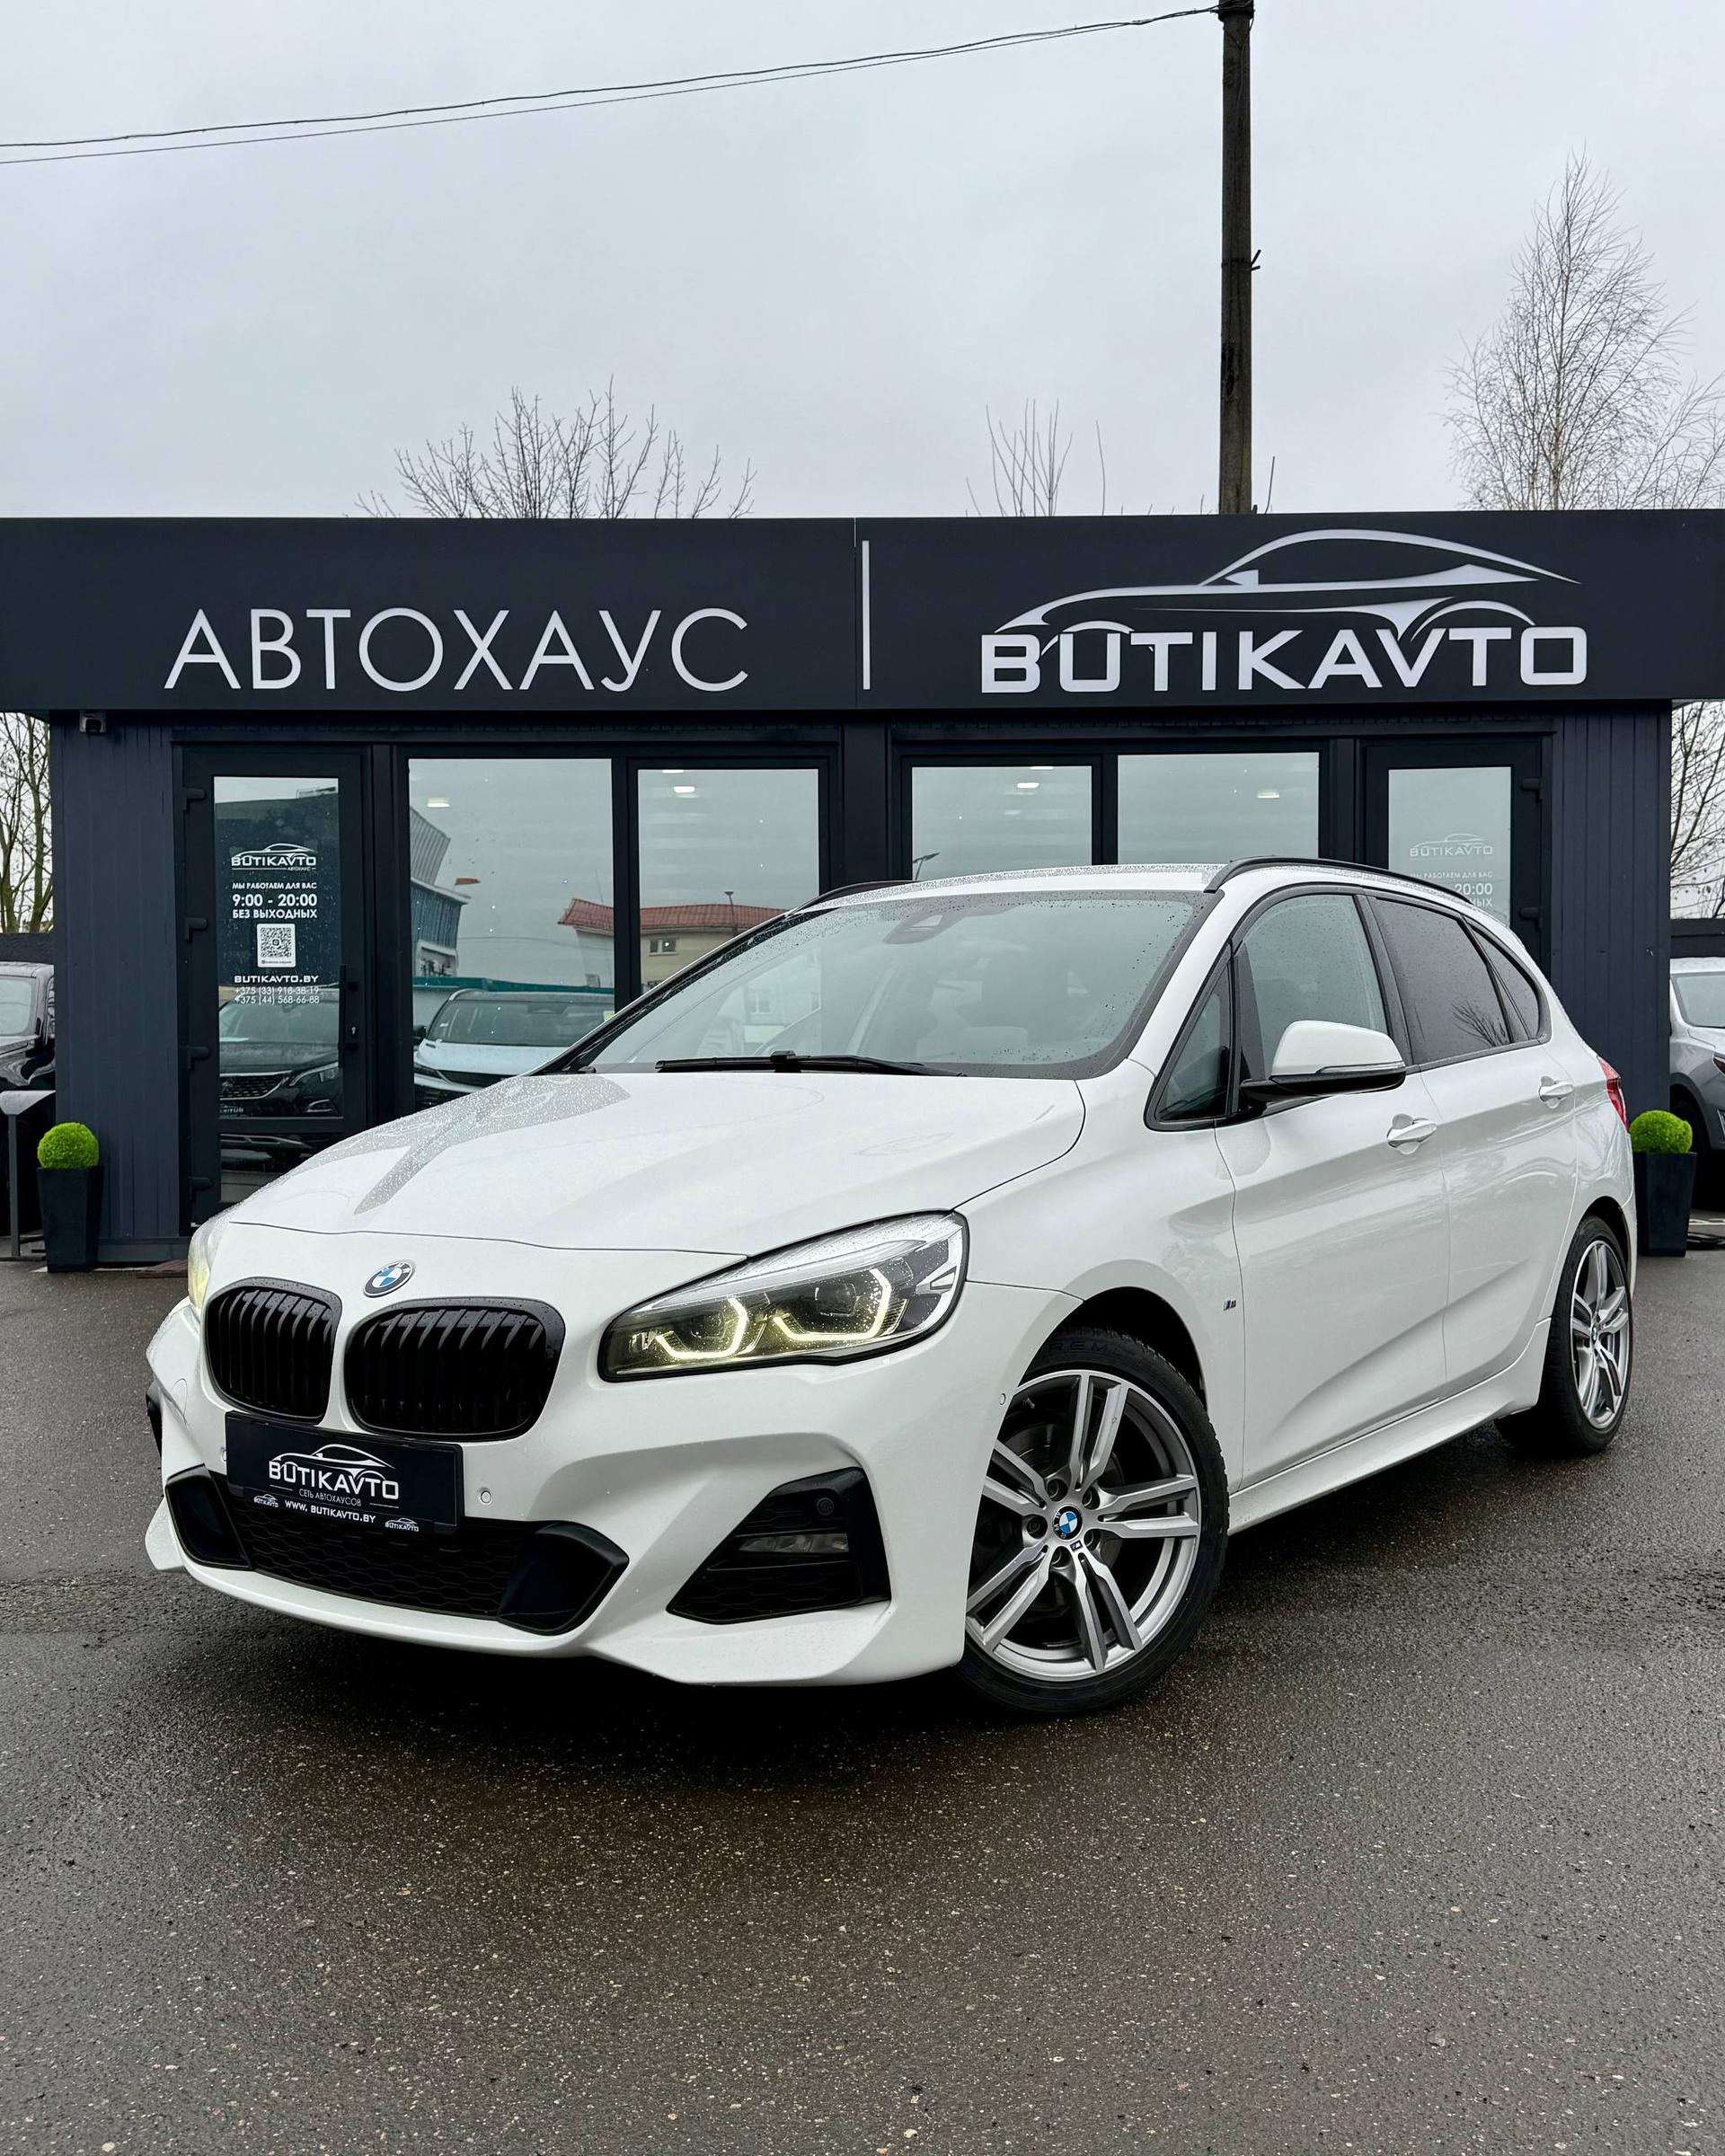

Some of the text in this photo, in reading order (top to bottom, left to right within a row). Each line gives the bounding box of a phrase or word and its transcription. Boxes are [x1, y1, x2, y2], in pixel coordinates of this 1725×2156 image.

[164, 607, 748, 693] АВТОХАУС
[981, 625, 1588, 694] BUTIKAVTO
[1410, 845, 1493, 857] BUTIKAVTO
[231, 856, 316, 867] BUTIKAVTO
[232, 893, 263, 907] 9:00
[278, 893, 317, 907] 20:00
[232, 909, 317, 919] БЕЗ ВЫХОДНЫХ
[234, 975, 319, 984] BUTIKAVTO.BY
[258, 995, 275, 1005] (44)
[277, 995, 320, 1004] 568-66-88
[269, 1461, 399, 1500] BUTIKAVTO
[298, 1488, 362, 1507] СЕТЬ АВТОХАУСОВ
